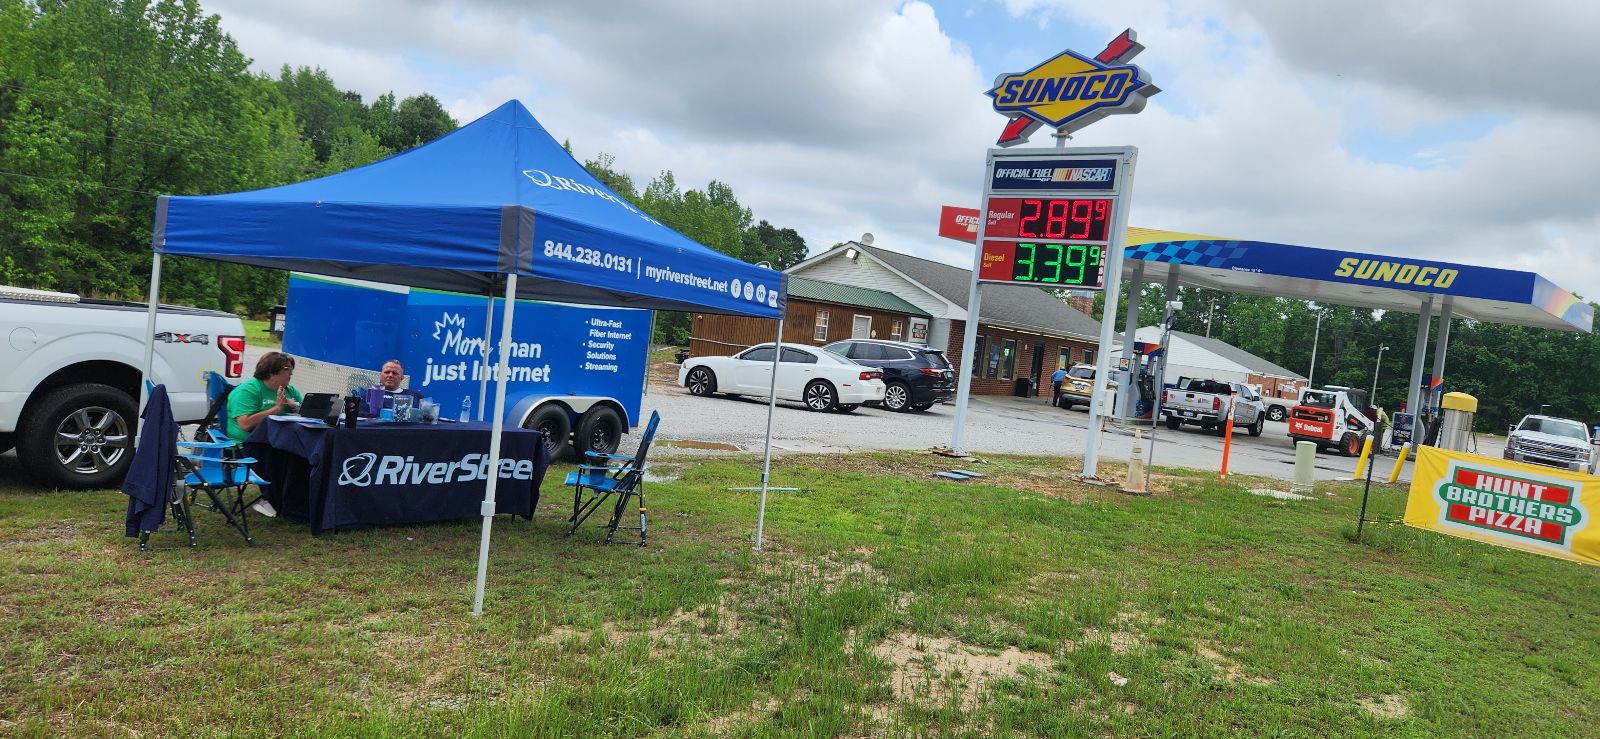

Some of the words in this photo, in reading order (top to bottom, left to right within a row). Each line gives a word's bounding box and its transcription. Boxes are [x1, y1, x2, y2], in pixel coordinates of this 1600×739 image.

[999, 73, 1129, 104] SUNOCO
[996, 168, 1031, 178] OFFICIAL
[1032, 168, 1053, 178] FUEL
[1070, 168, 1109, 181] NASCAR
[988, 210, 1015, 221] Regular
[983, 252, 1005, 262] Diesel
[544, 240, 633, 273] 844.238.0131
[645, 265, 729, 294] myriverstreet.net
[1334, 257, 1459, 289] SUNOCO
[591, 318, 622, 328] Ultra-Fast
[589, 329, 606, 338] Fiber
[607, 331, 632, 340] Internet
[441, 329, 493, 357] More
[587, 340, 615, 351] Security
[586, 351, 617, 361] Solutions
[422, 357, 467, 387] just
[585, 362, 618, 373] Streaming
[1303, 423, 1323, 433] Bobcat
[375, 453, 532, 485] RiverStee
[1475, 474, 1547, 501] HUNT
[1446, 485, 1573, 523] BROTHERS
[1468, 505, 1542, 534] PIZZA
